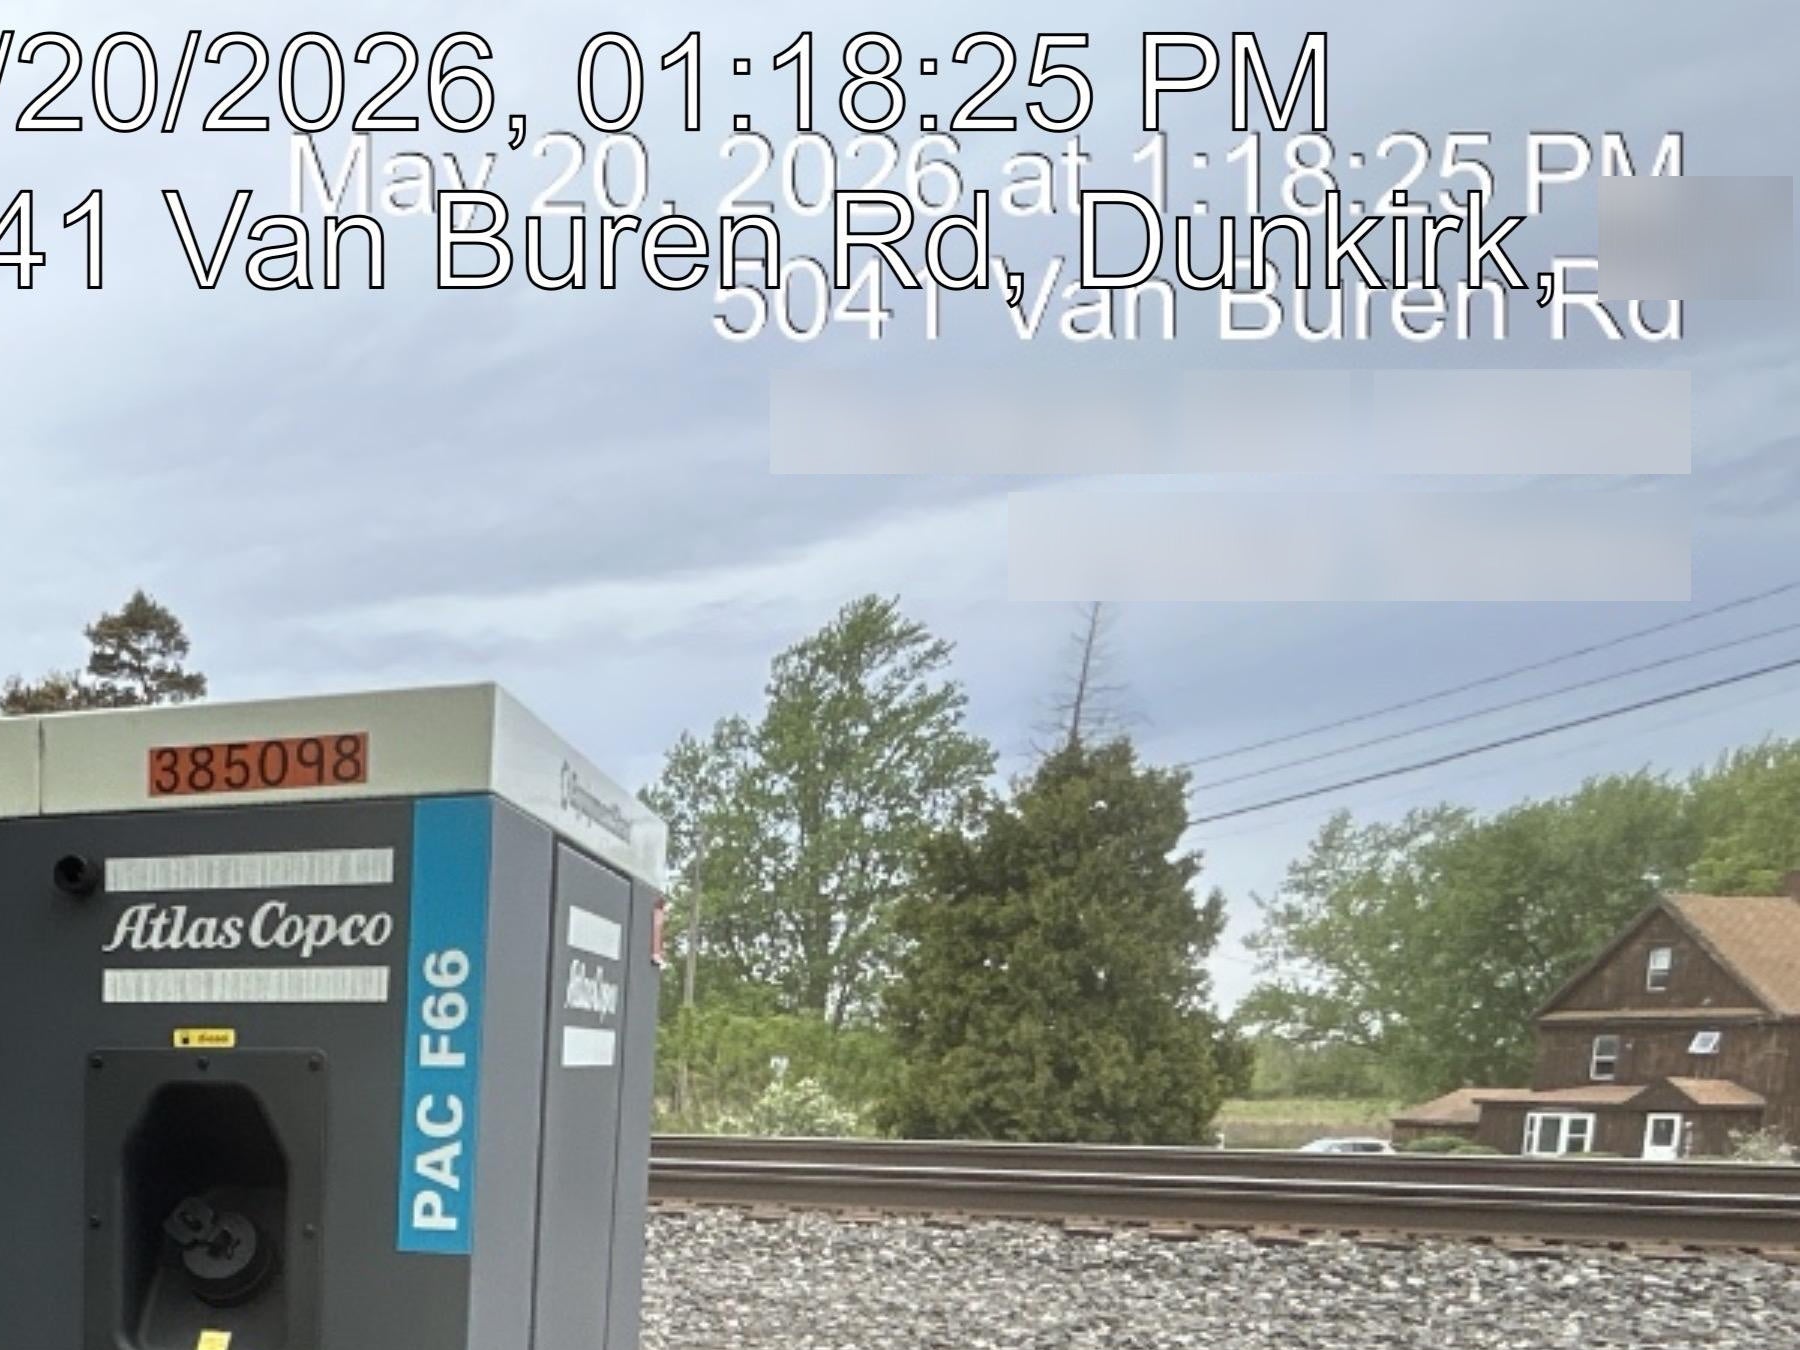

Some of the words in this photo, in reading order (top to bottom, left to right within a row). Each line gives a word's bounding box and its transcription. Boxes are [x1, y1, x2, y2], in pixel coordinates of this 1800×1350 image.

[154, 734, 362, 794] 385098
[418, 948, 470, 1068] F66
[412, 1093, 464, 1232] PAC
